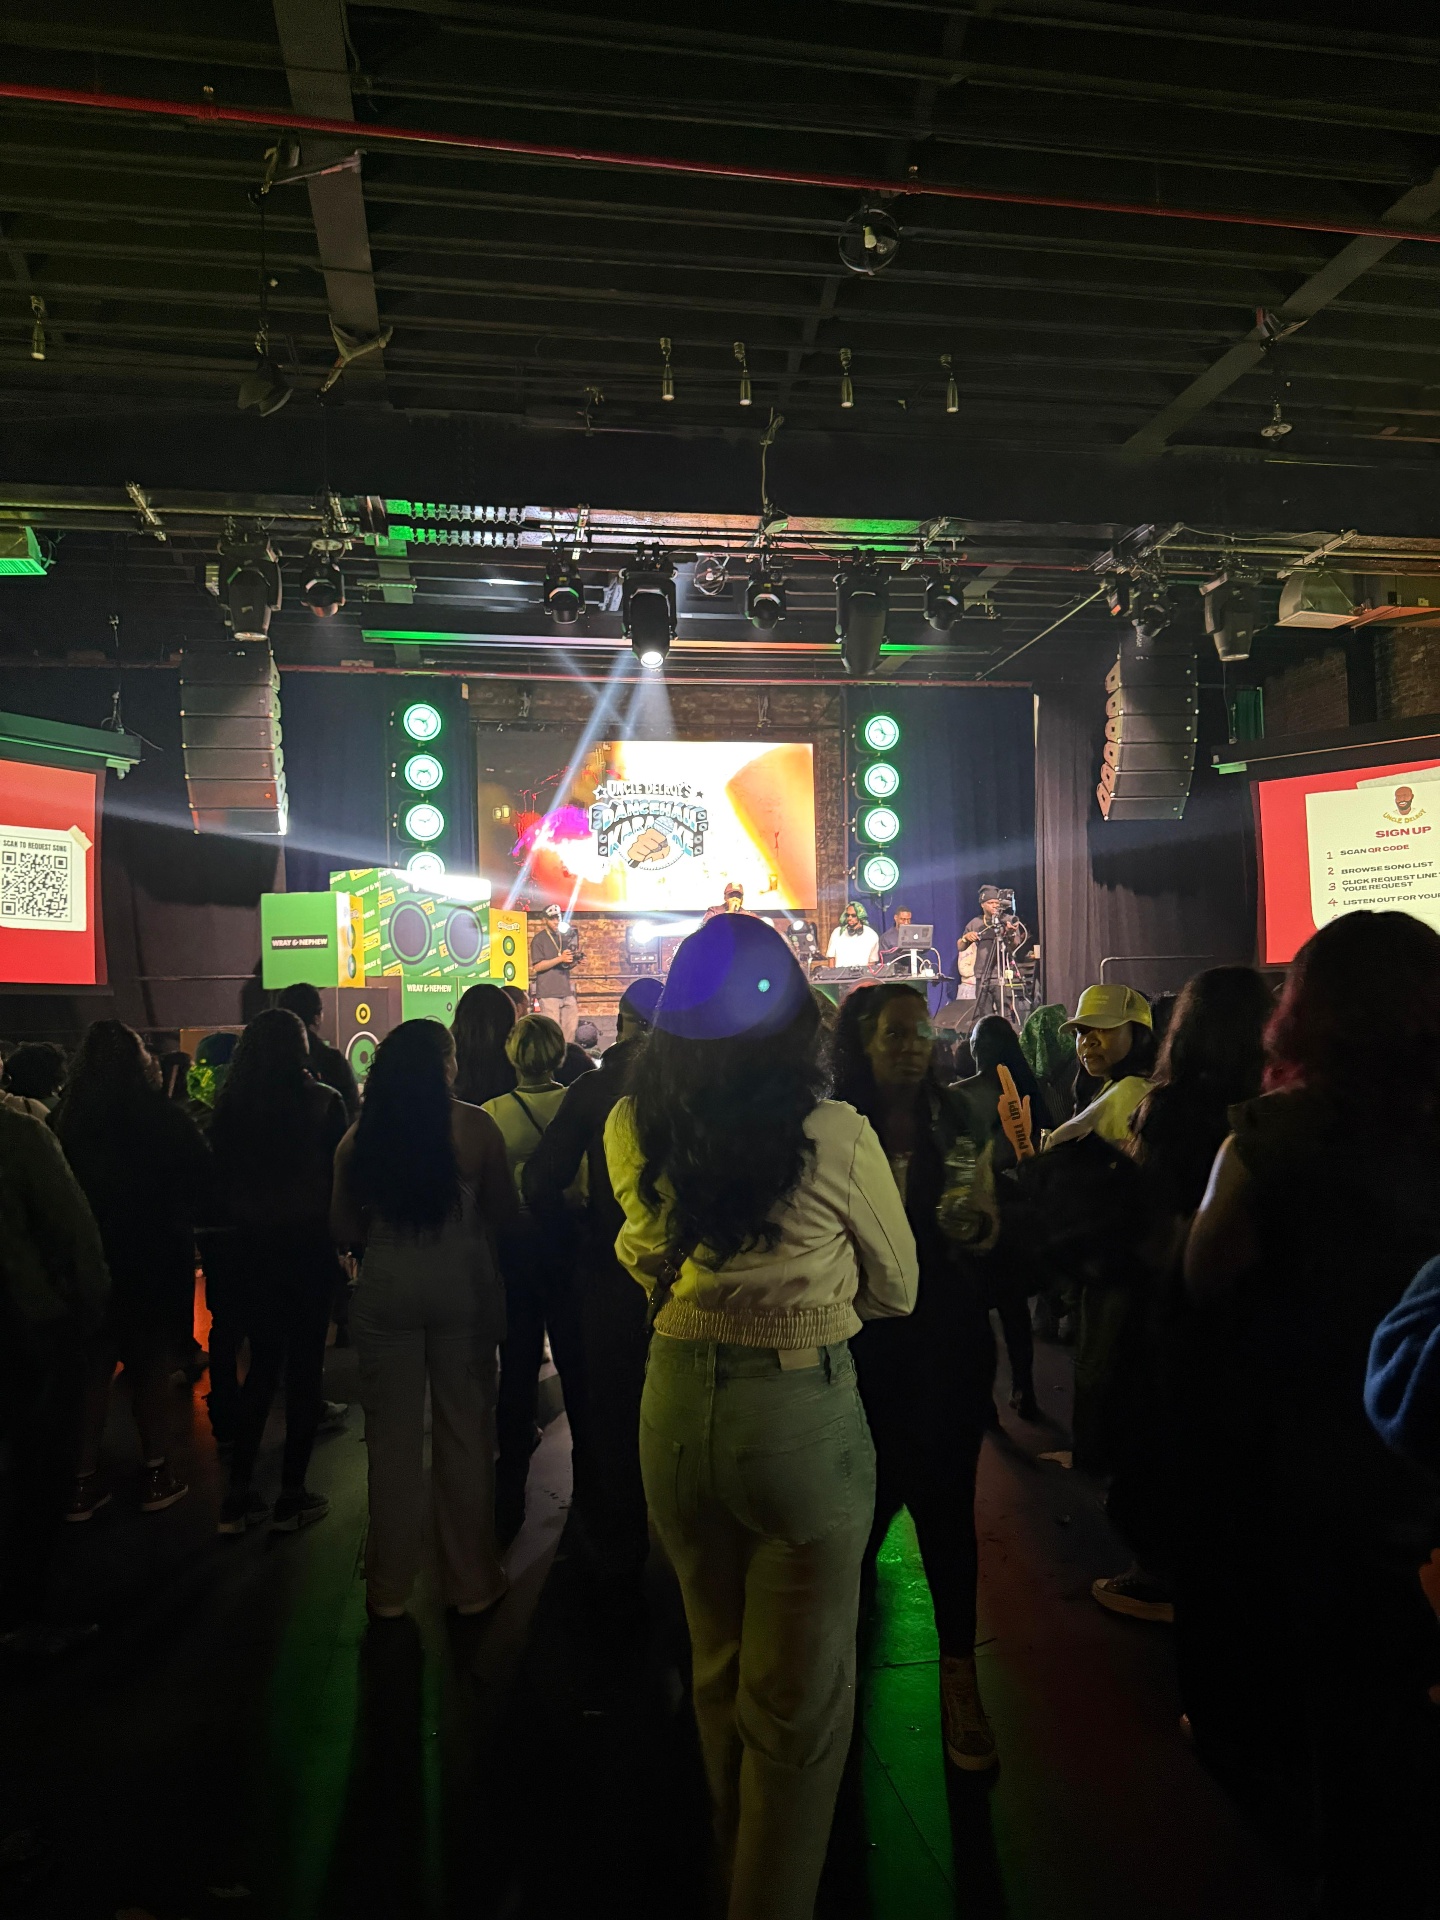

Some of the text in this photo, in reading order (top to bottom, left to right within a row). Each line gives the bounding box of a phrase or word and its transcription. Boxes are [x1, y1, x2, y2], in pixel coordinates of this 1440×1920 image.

[608, 782, 644, 797] UNCLE
[601, 798, 697, 833] DANCEHALL
[1383, 812, 1402, 824] UNCLE
[1375, 826, 1432, 838] SIGN UP
[28, 842, 51, 851] REQUEST
[1340, 848, 1367, 856] SCAN
[1368, 846, 1381, 854] QR
[1327, 867, 1335, 875] 2
[1341, 866, 1383, 875] BROWSE
[1384, 863, 1412, 871] SONG
[1342, 878, 1370, 886] CLICK
[1371, 874, 1416, 883] REQUEST
[1369, 881, 1413, 890] REQUEST
[1328, 883, 1336, 891] 3
[1327, 897, 1338, 907] 4
[1343, 898, 1376, 906] LISTEN
[1397, 893, 1416, 901] FOR
[272, 939, 291, 947] WRAY
[298, 938, 328, 946] NEPHEW
[406, 984, 423, 992] WRAY
[429, 984, 452, 993] NEPHEW
[1013, 1123, 1028, 1150] PULL
